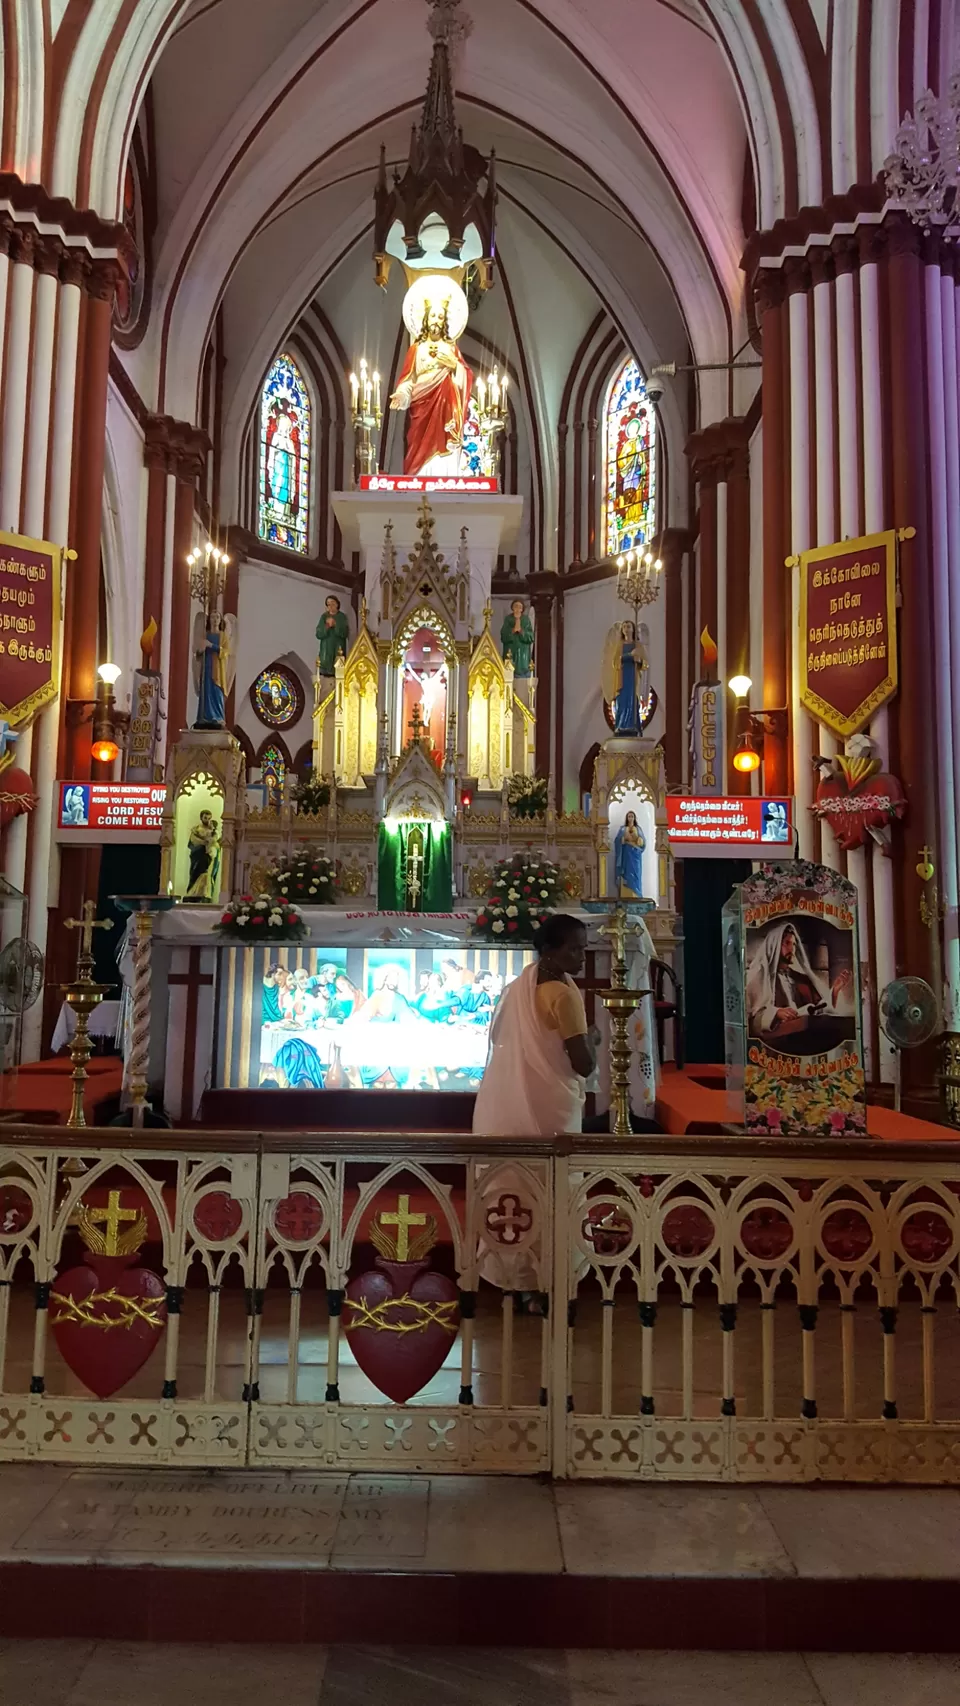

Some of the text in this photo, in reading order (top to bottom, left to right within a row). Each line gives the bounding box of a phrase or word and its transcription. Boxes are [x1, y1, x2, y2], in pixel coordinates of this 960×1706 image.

[812, 560, 881, 588] இக்கோவிலை
[0, 586, 35, 607] தயமும்
[830, 592, 862, 616] நானே
[8, 638, 52, 664] இருக்கும்
[701, 691, 717, 787] ALLELUIA
[97, 816, 129, 825] COME
[132, 817, 143, 826] IN
[107, 806, 135, 815] LORD
